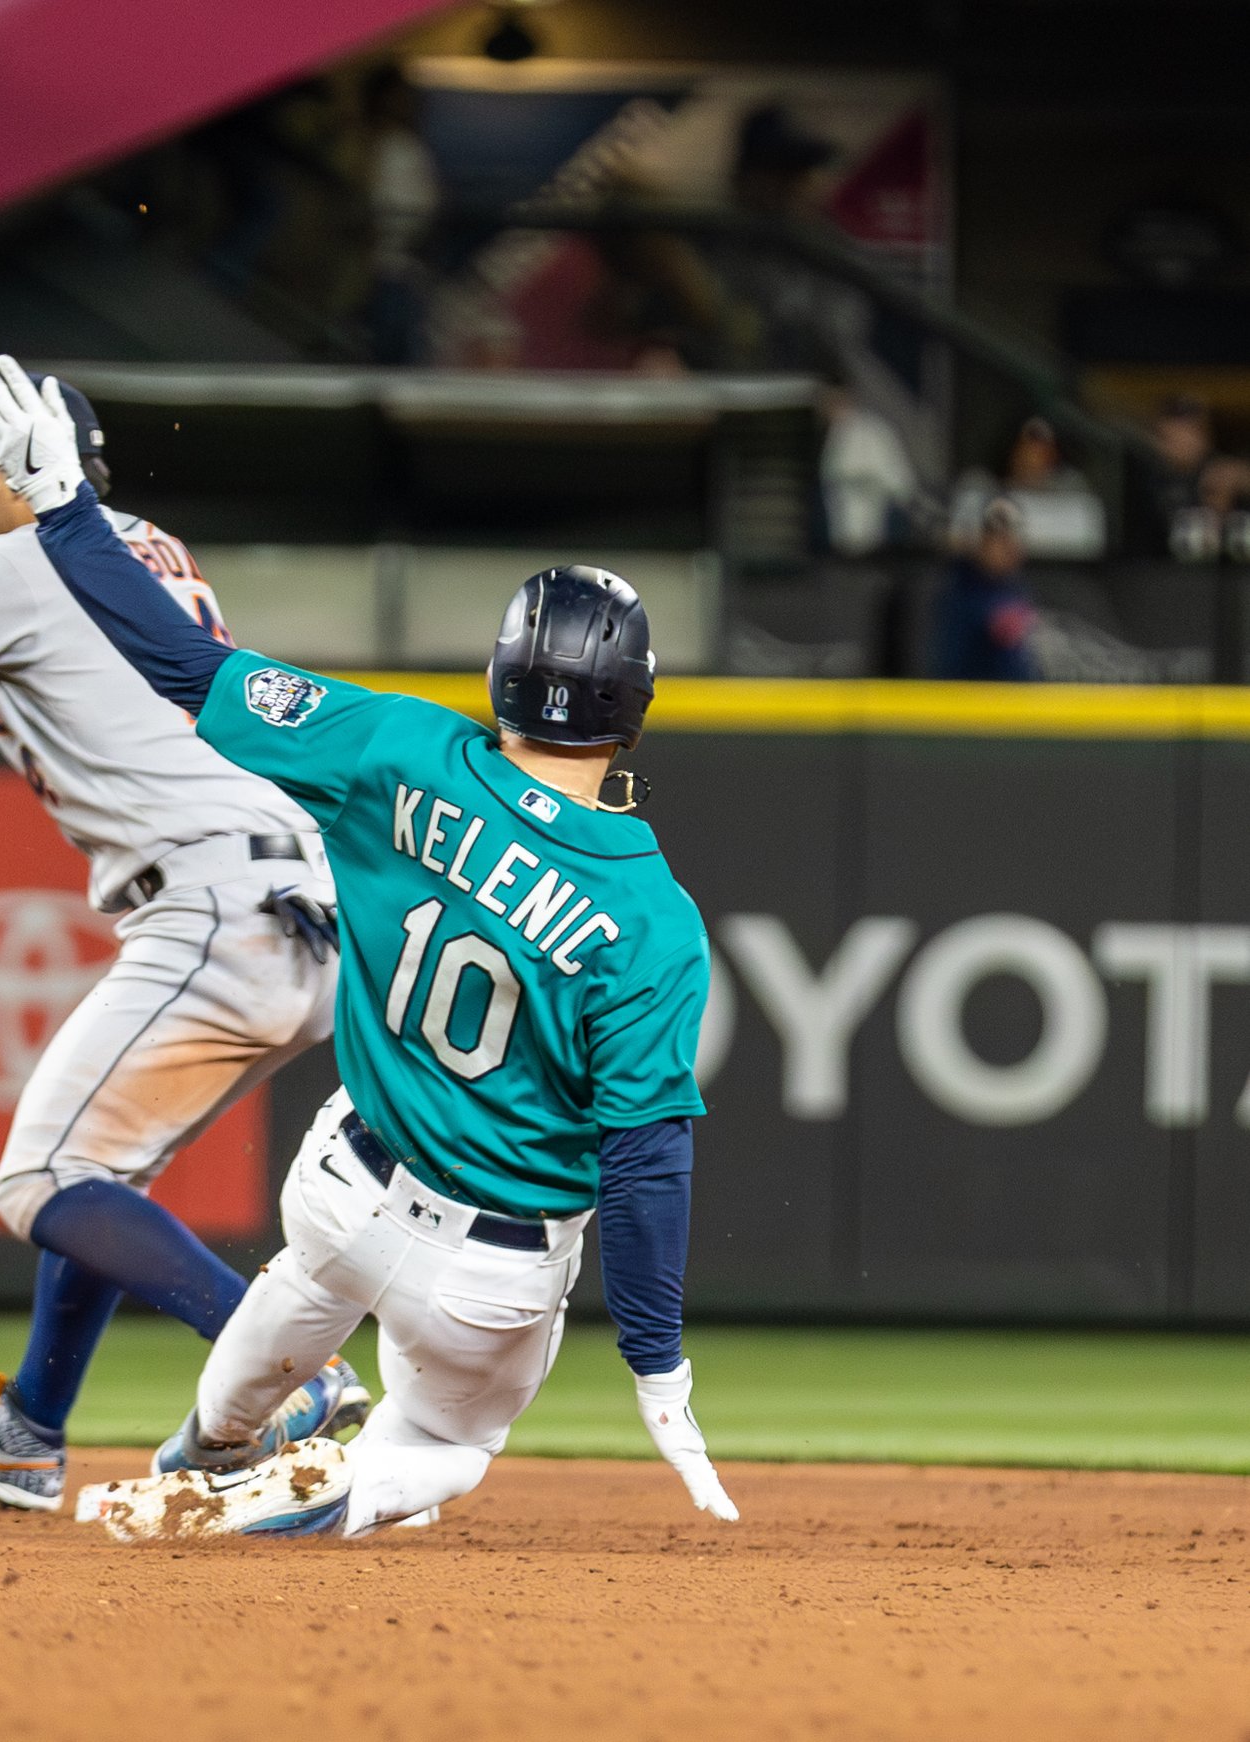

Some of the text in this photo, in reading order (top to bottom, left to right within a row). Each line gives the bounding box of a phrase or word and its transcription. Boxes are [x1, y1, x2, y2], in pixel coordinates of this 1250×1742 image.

[547, 686, 569, 707] 10
[393, 781, 621, 977] KELENIC
[385, 896, 523, 1081] 10
[699, 912, 1250, 1128] YOT
